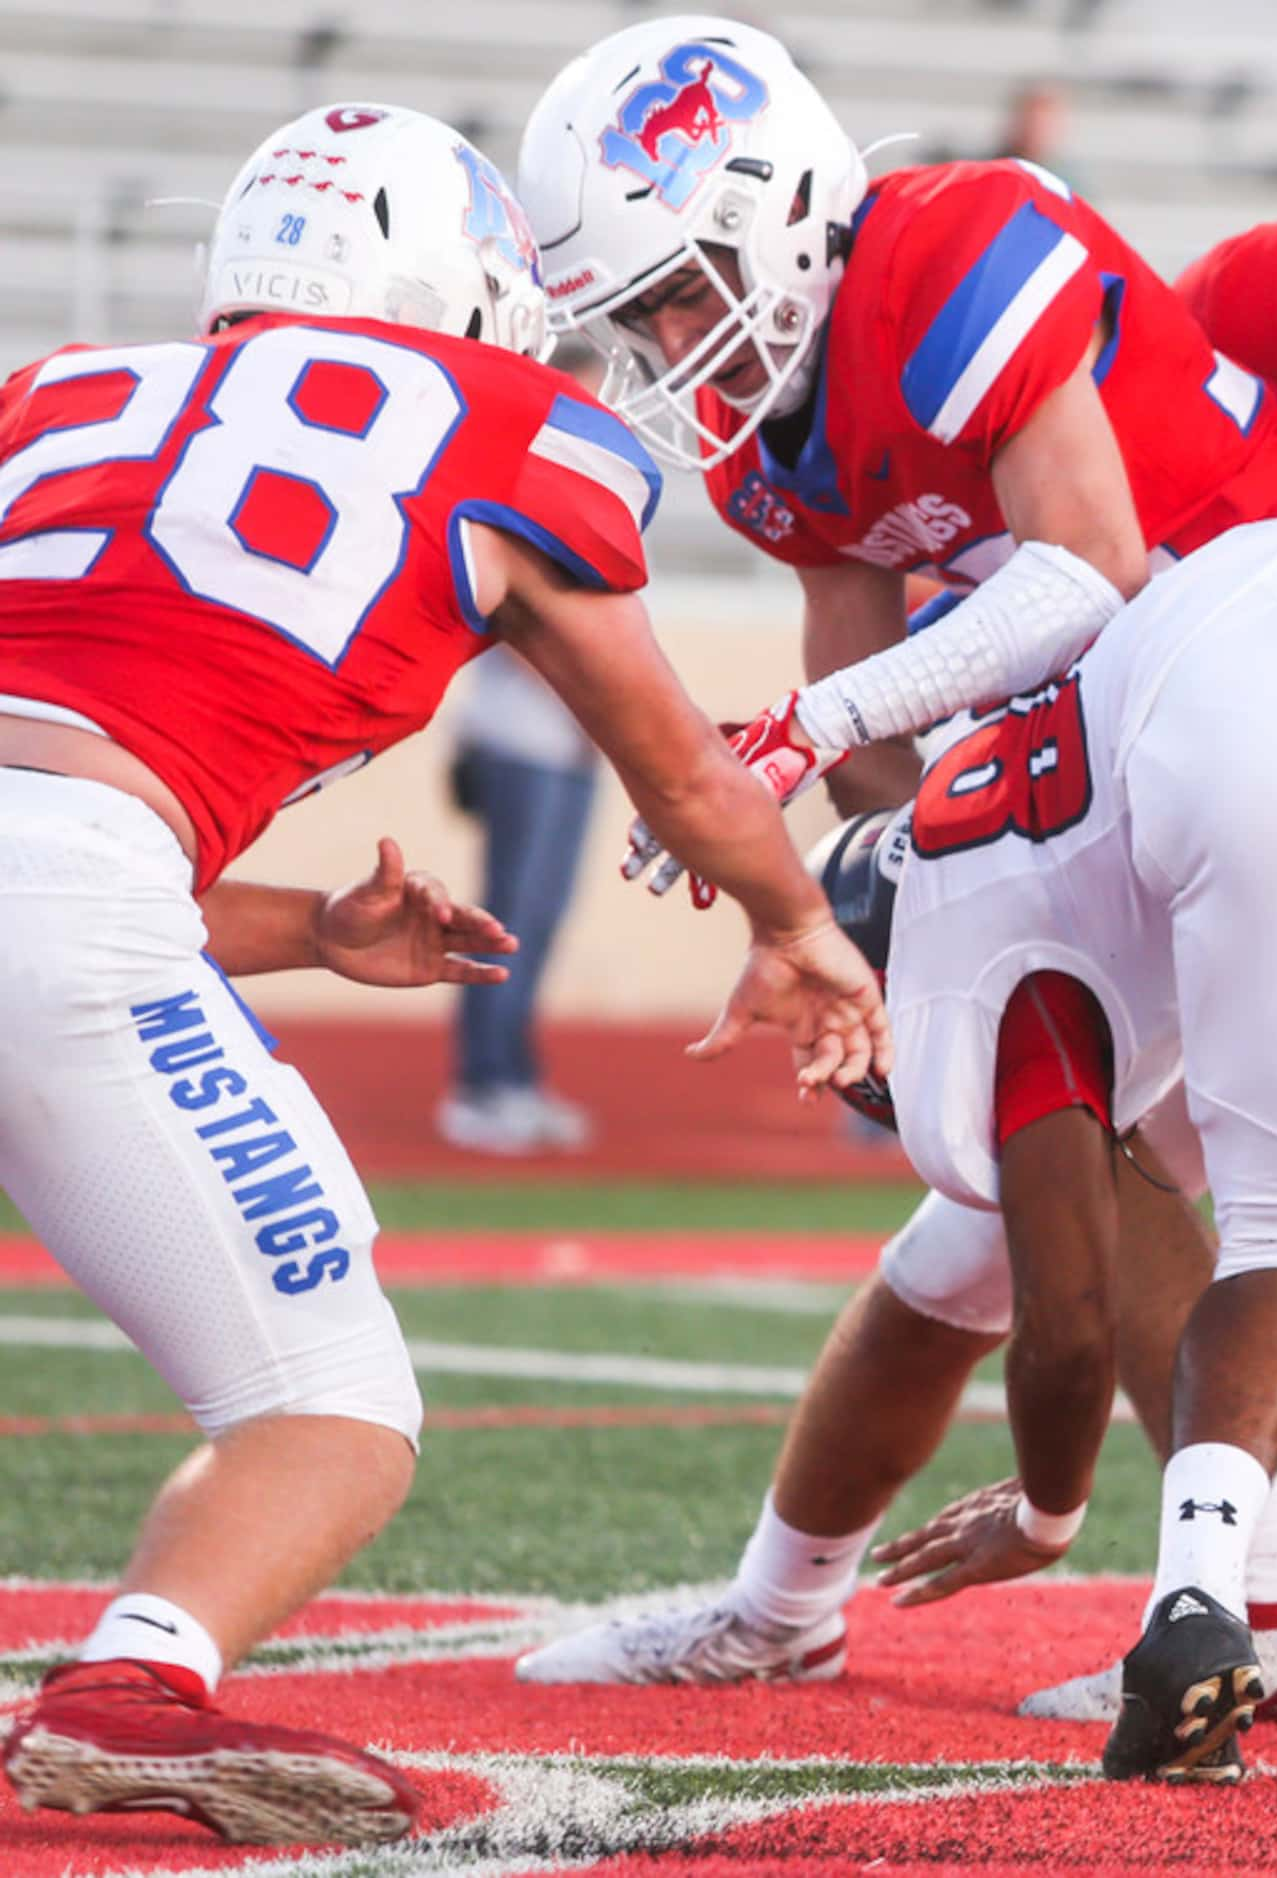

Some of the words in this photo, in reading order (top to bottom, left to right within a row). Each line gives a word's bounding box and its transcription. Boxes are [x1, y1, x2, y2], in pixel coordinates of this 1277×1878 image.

[232, 271, 330, 306] VICIS
[275, 213, 306, 246] 28
[0, 325, 470, 673] 28
[129, 989, 350, 1296] MUSTANGS
